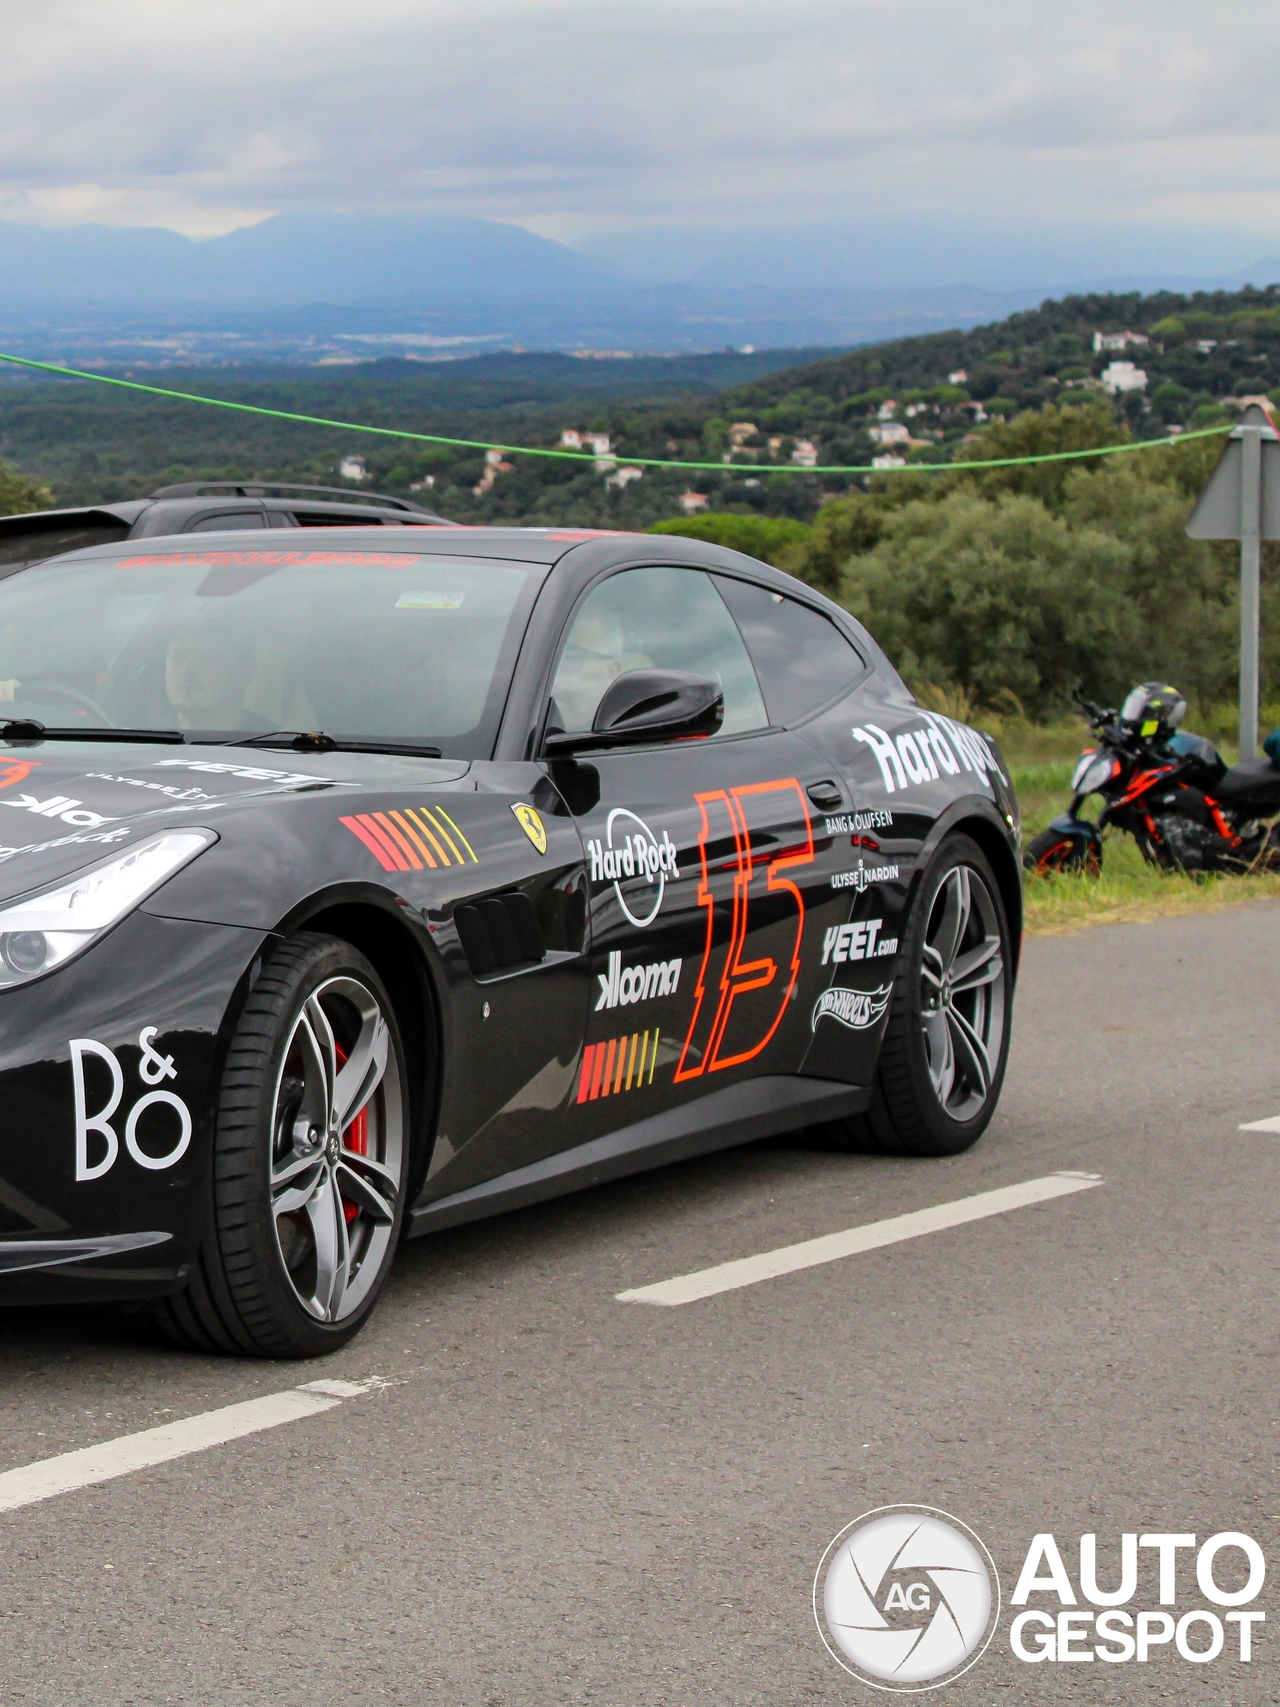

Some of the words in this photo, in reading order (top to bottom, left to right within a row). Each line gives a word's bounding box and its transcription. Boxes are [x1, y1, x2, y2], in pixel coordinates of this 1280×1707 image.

[851, 712, 960, 793] Hard
[85, 772, 181, 796] ULYSSE
[826, 816, 848, 834] BANG
[854, 810, 893, 830] OLUFSEN
[588, 835, 635, 881] Hard
[633, 831, 680, 883] Rock
[831, 871, 859, 889] ULYSSE
[864, 865, 899, 883] NARDIN
